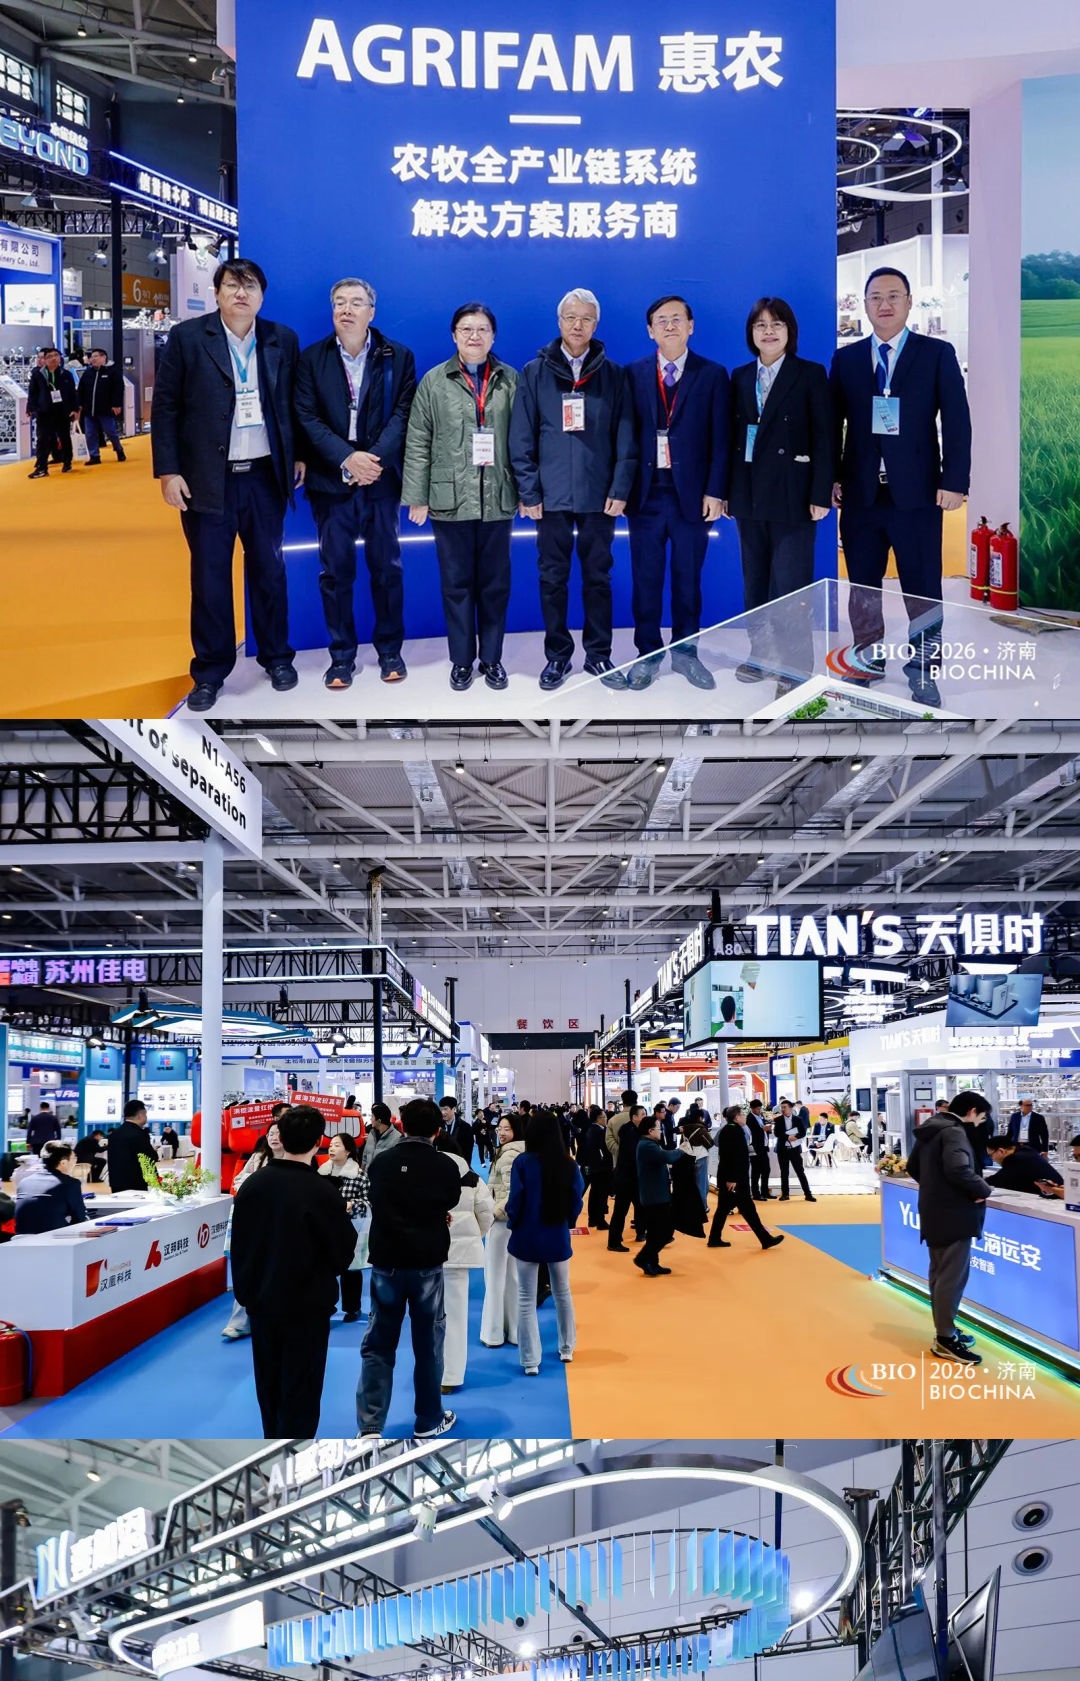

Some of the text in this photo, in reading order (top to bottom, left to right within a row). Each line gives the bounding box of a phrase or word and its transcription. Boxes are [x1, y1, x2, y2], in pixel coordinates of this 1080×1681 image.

[296, 18, 784, 93] AGRIFAM 惠农
[391, 143, 698, 187] 农牧全产业链系统
[410, 198, 679, 240] 解决方案服务商
[0, 239, 40, 257] 有限公司
[133, 279, 141, 303] 6
[149, 728, 246, 830] of separation
[202, 734, 246, 794] N1-A56
[714, 943, 743, 956] A80
[746, 910, 1044, 956] TIAN'S 天俱时
[45, 958, 147, 985] 苏州佳电
[516, 1018, 580, 1030] 餐饮区
